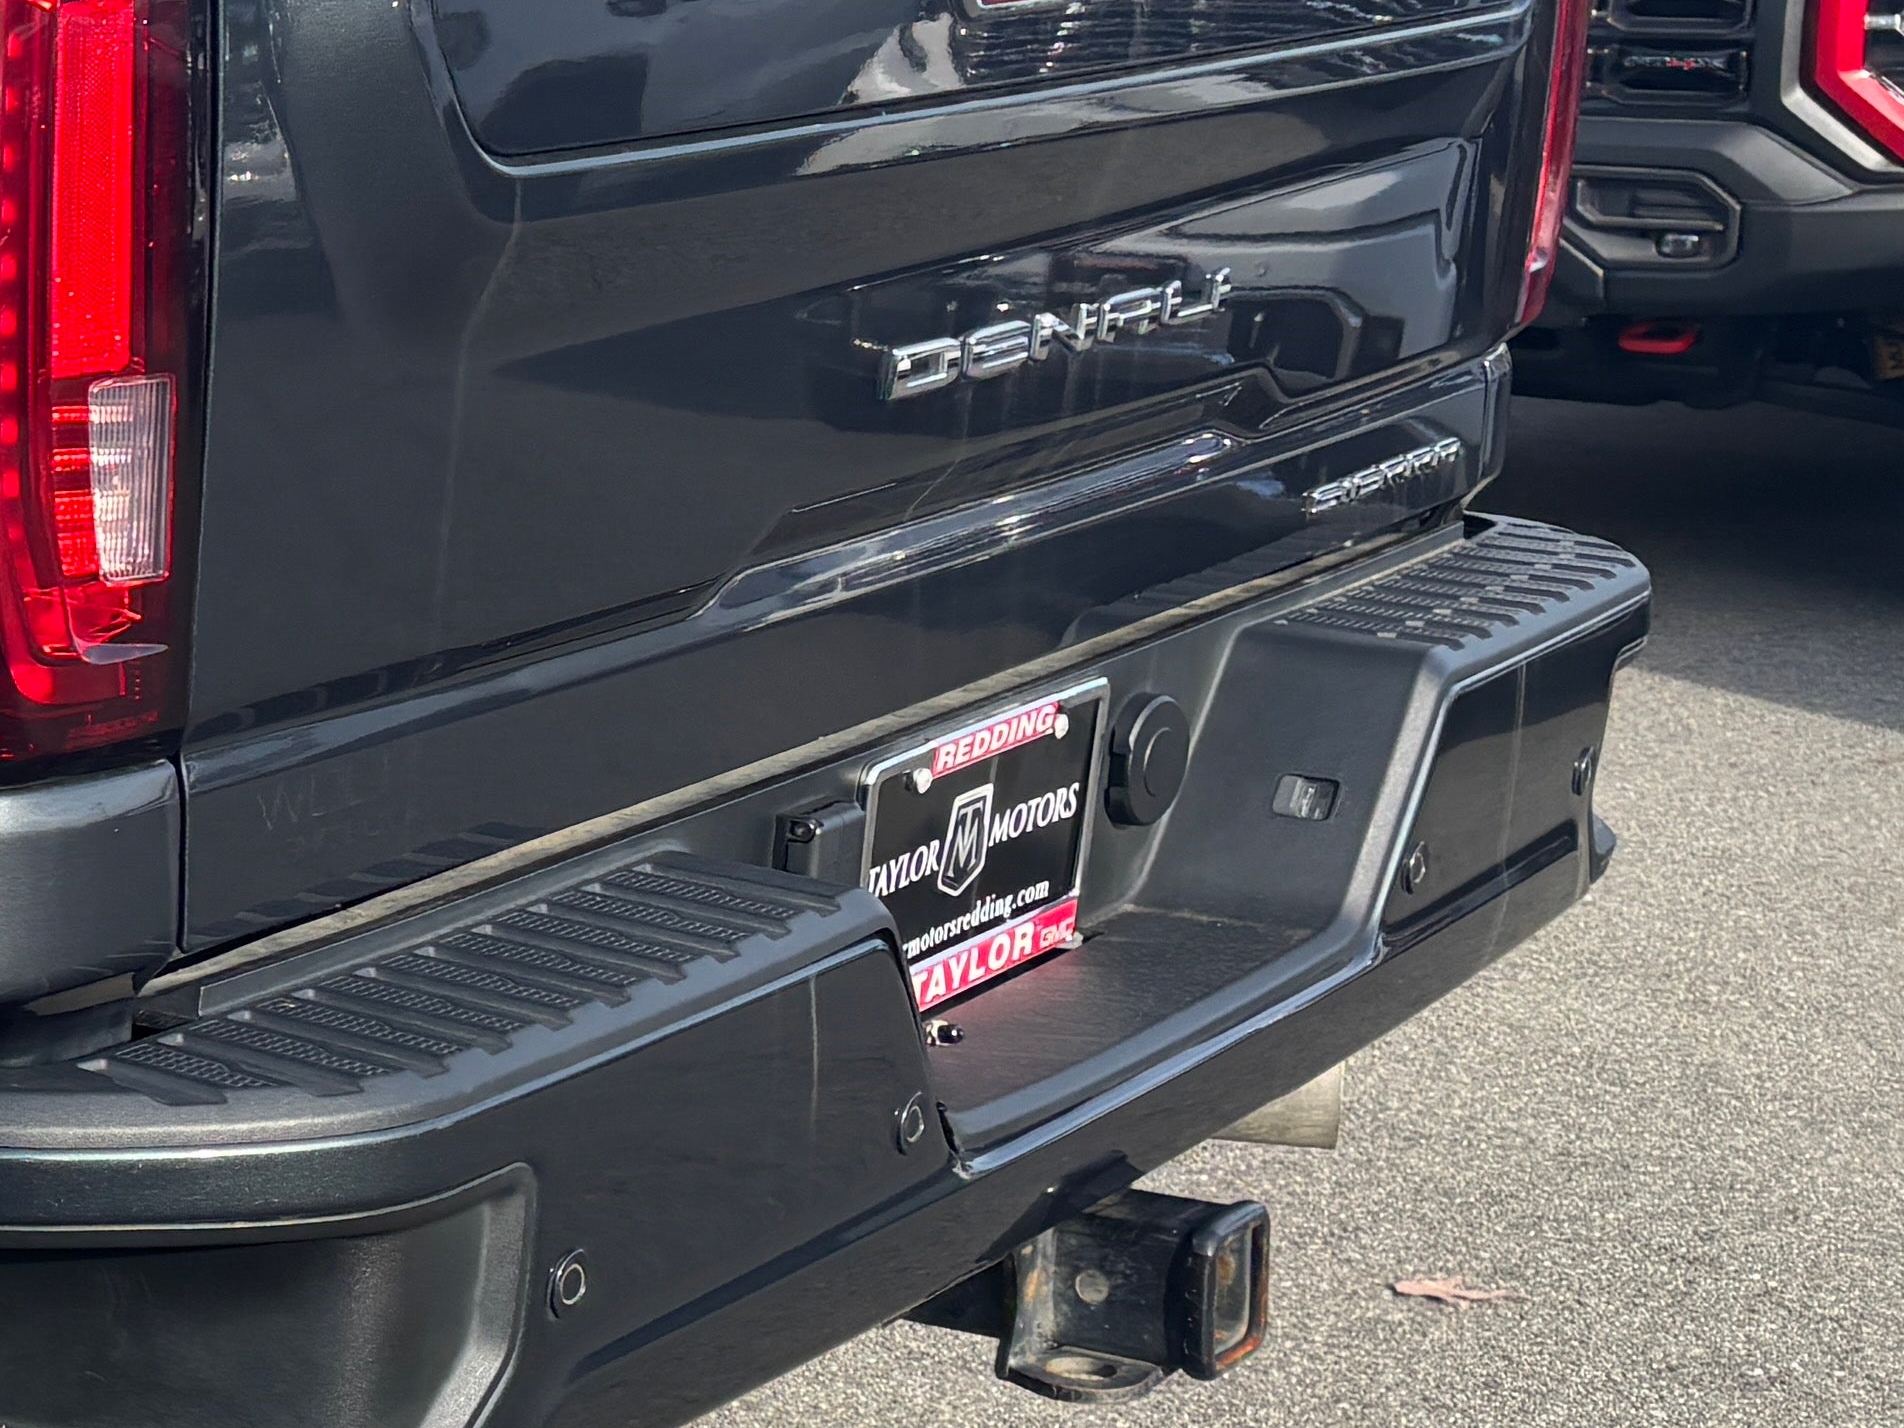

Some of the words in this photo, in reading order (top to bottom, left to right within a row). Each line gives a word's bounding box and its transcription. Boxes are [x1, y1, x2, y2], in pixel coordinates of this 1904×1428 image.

[884, 267, 1232, 401] DENALI
[935, 703, 1058, 772] REDDING
[868, 839, 941, 899] TAYLOR
[989, 781, 1081, 848] MOTORS
[911, 921, 1036, 1007] TAYLOR
